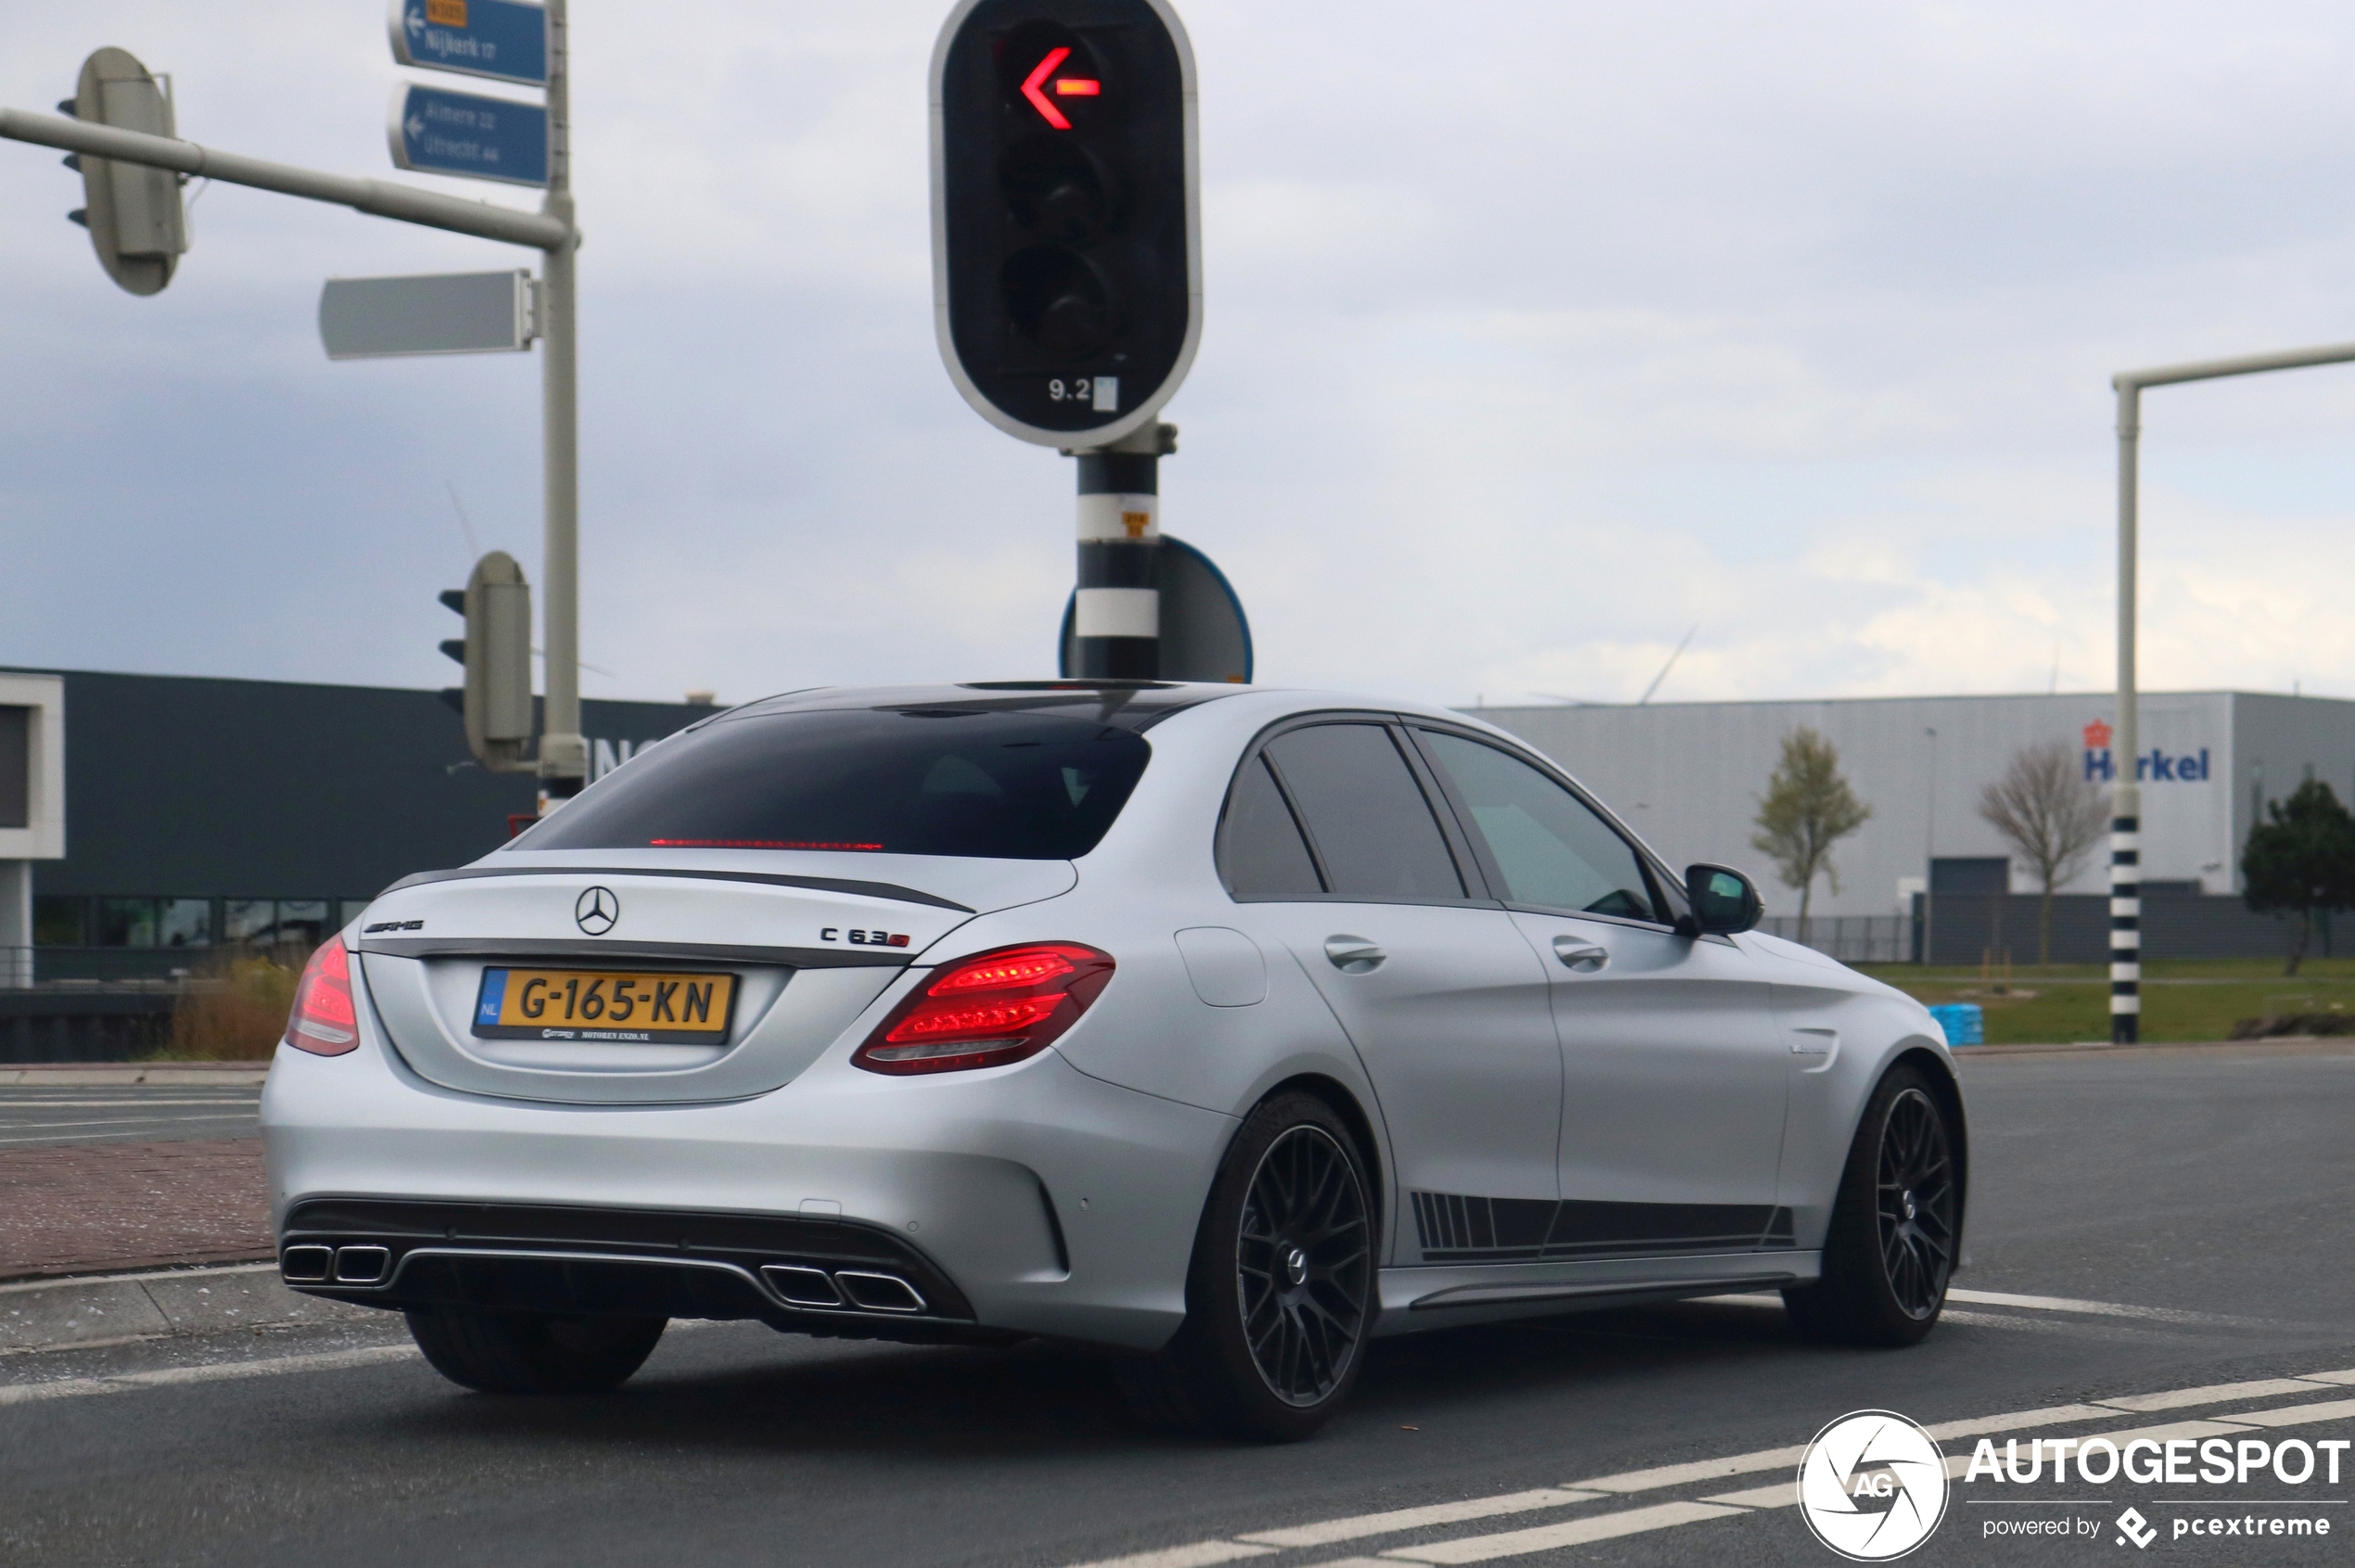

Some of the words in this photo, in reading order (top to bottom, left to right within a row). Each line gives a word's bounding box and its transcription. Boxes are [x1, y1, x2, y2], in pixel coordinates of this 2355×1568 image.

[425, 30, 478, 57] Nijkerk
[1049, 378, 1091, 402] 9.2
[374, 920, 425, 933] AMG
[821, 928, 838, 941] C
[519, 977, 714, 1023] G-165-KN
[481, 1003, 497, 1016] NL
[581, 1031, 617, 1039] MOTOREN
[617, 1032, 650, 1040] ENZO.NL
